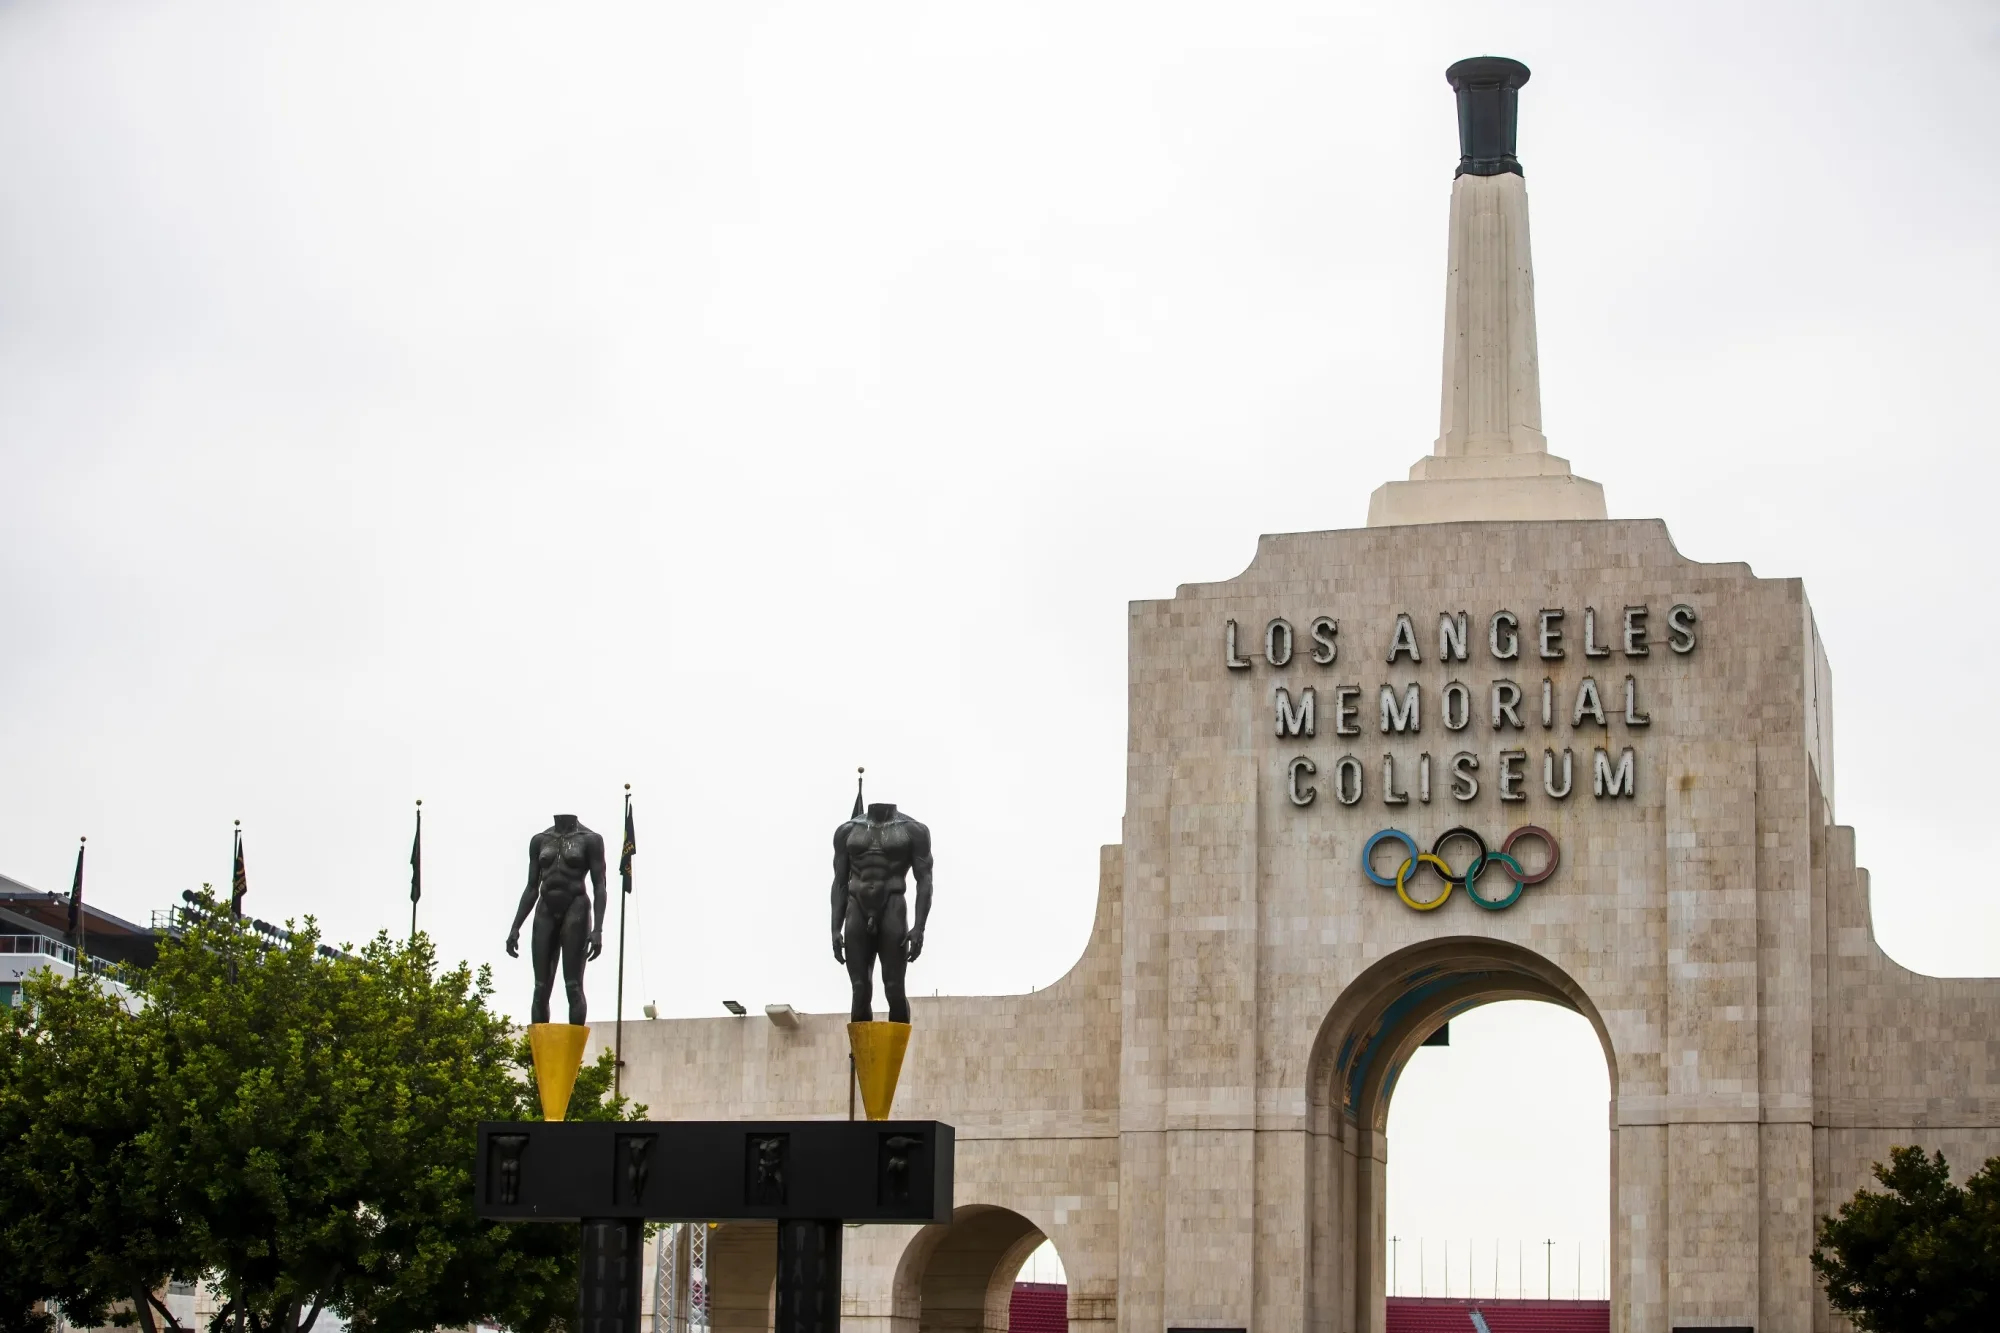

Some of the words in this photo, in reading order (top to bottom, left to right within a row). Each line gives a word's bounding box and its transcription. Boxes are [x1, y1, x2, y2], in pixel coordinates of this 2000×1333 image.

[1227, 616, 1338, 669] LOS
[1386, 604, 1696, 663] ANGELES
[1275, 674, 1650, 737] MEMORIAL
[1288, 747, 1635, 806] COLISEUM
